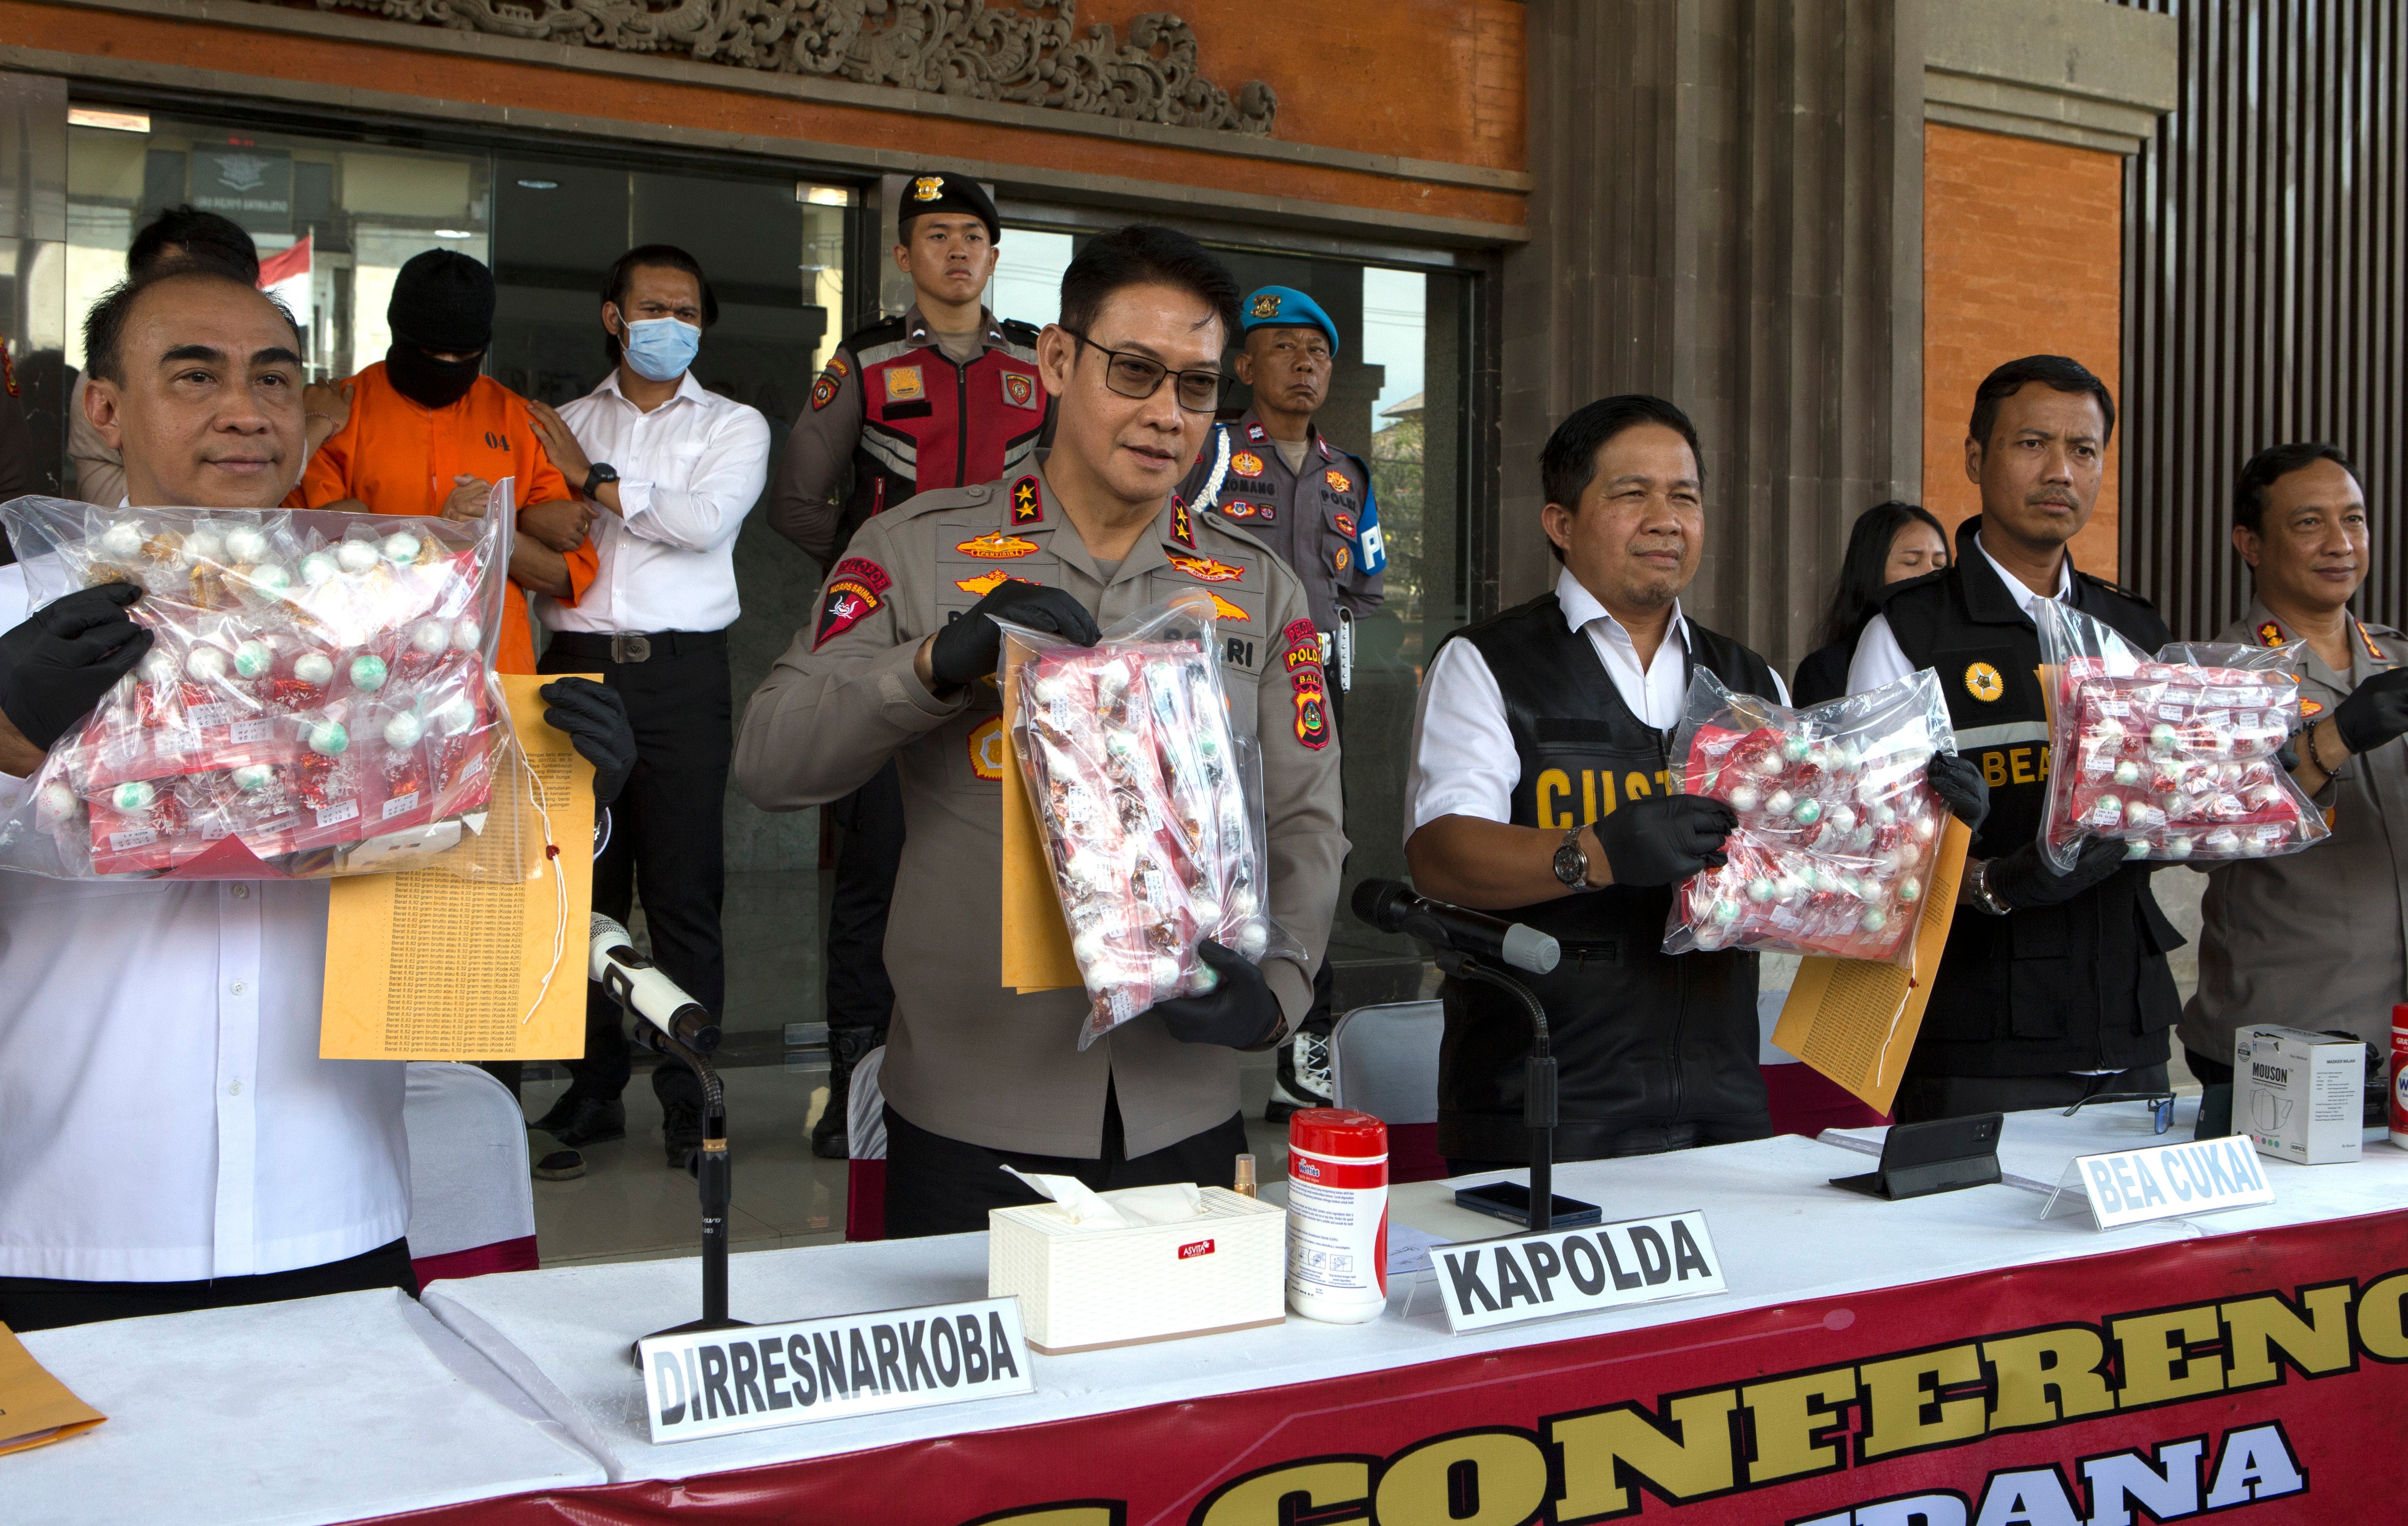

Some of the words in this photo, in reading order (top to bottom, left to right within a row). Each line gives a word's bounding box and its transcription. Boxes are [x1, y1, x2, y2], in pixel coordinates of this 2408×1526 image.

[484, 430, 510, 452] 04
[1321, 489, 1356, 513] POLRI
[829, 582, 852, 594] KORPS
[851, 584, 878, 608] BRIMOB
[1299, 674, 1320, 684] BALI
[1983, 747, 2050, 787] BEA
[2252, 1062, 2288, 1083] MOUSON
[1298, 1162, 1320, 1177] Wetties
[2088, 1154, 2168, 1215] BEA
[2160, 1140, 2264, 1202] CUKAI
[1183, 1244, 1205, 1256] ASVITA
[1443, 1219, 1713, 1316] KAPOLDA
[653, 1311, 1019, 1426] DIRRESNARKOBA
